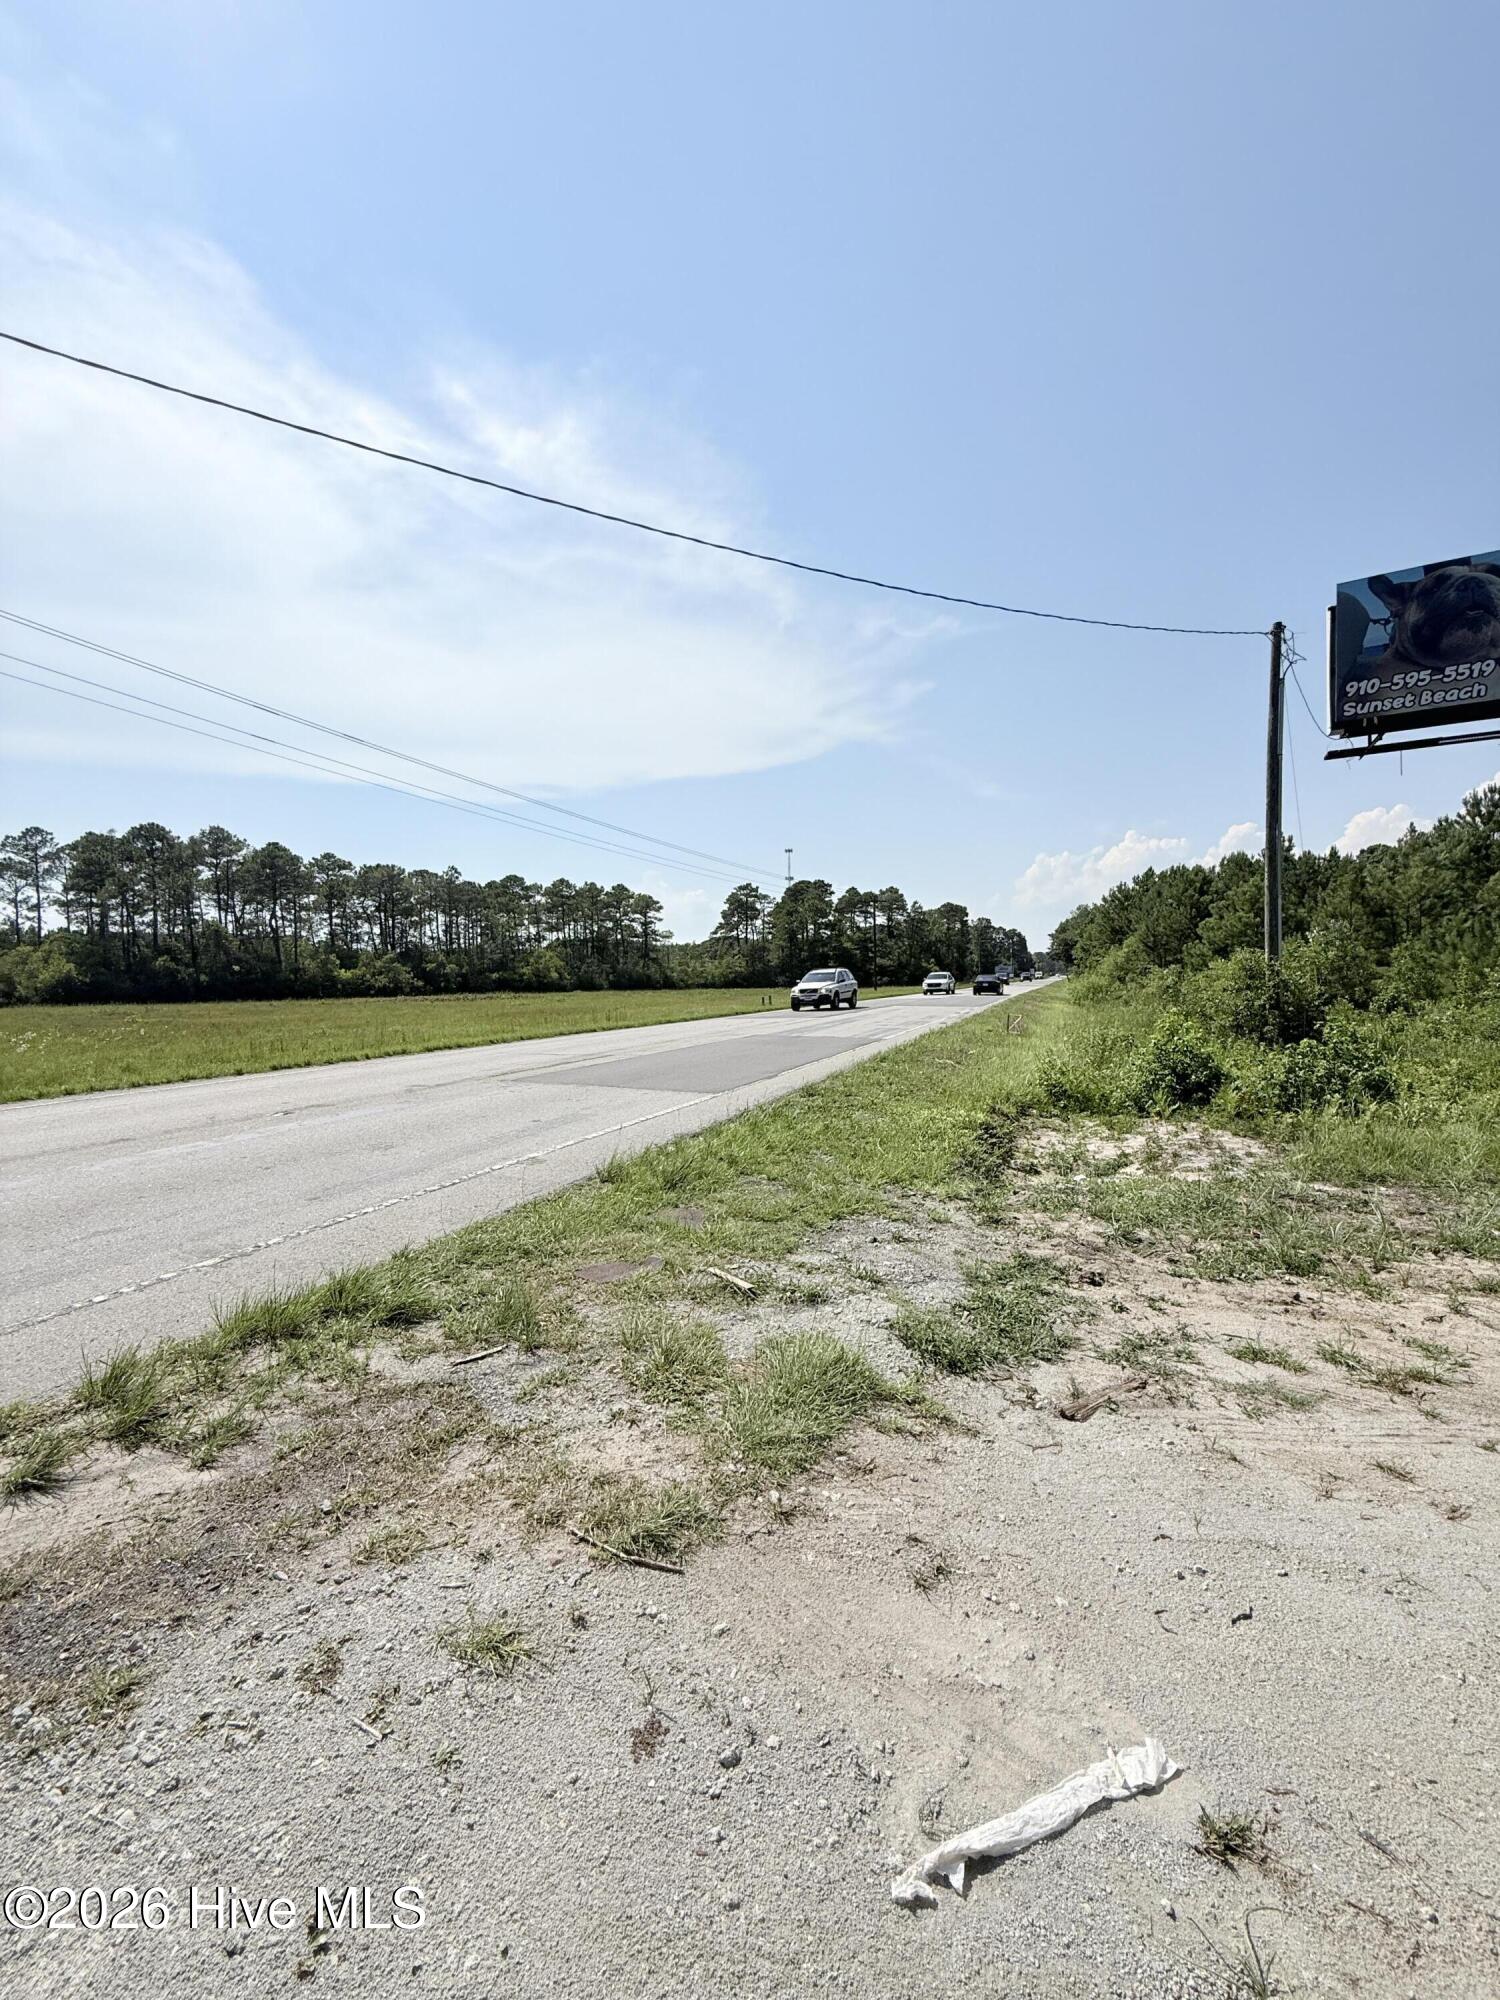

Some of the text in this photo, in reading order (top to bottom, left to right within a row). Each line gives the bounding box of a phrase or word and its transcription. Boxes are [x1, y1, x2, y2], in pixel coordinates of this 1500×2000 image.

[1345, 660, 1495, 697] 910-595-5519
[1343, 682, 1487, 716] Sunset Beach
